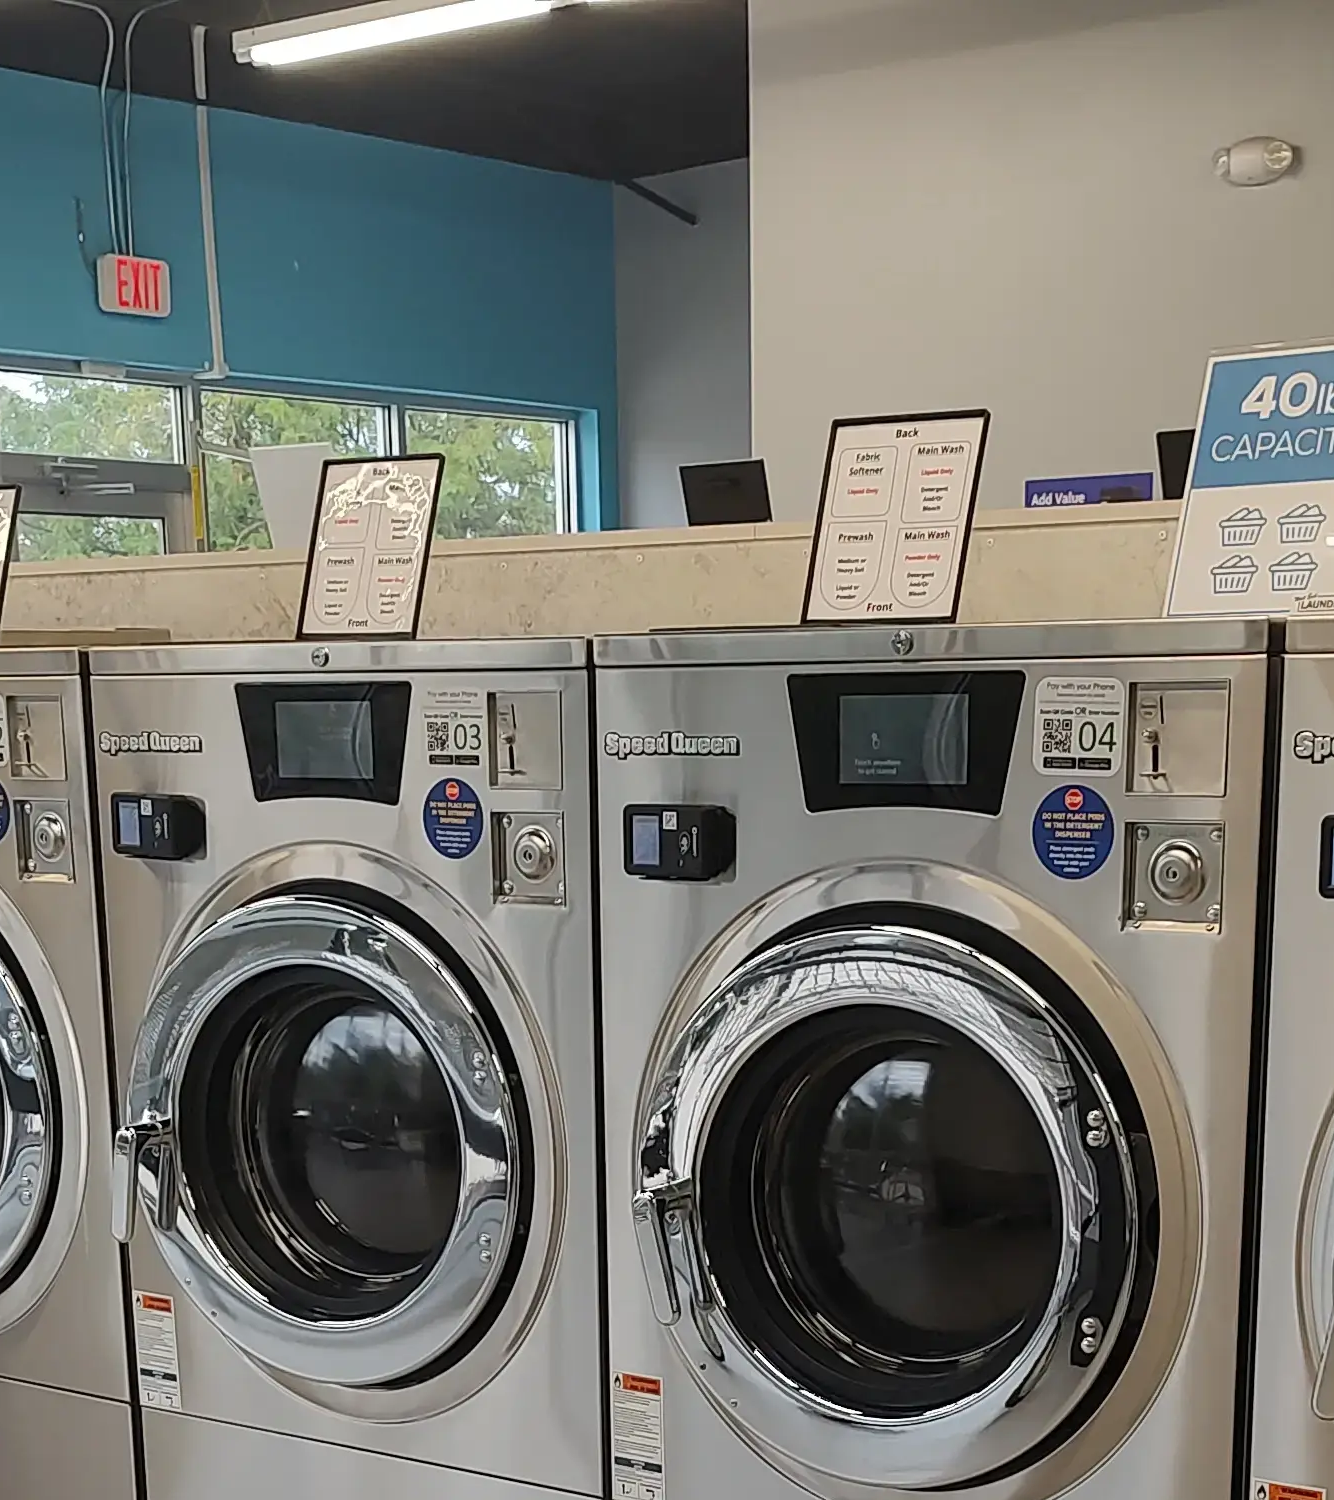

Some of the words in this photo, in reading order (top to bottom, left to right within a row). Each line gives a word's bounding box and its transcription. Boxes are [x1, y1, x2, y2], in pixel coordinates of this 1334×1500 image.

[117, 259, 161, 311] EXIT
[896, 428, 919, 438] Back
[918, 447, 939, 455] Main
[941, 445, 964, 453] Wash
[856, 453, 880, 462] Fabric
[373, 468, 390, 476] Back
[849, 467, 884, 475] Softener
[1032, 493, 1052, 506] Add
[1055, 492, 1085, 504] Value
[838, 533, 874, 541] Prewash
[928, 531, 950, 539] Wash
[867, 603, 893, 612] Front
[348, 619, 368, 627] Front
[1075, 707, 1086, 715] OR
[454, 724, 481, 750] 03
[1079, 721, 1116, 752] 04
[99, 731, 148, 756] Speed
[149, 731, 203, 752] Queen
[604, 732, 669, 760] Speed
[670, 732, 740, 756] Queen
